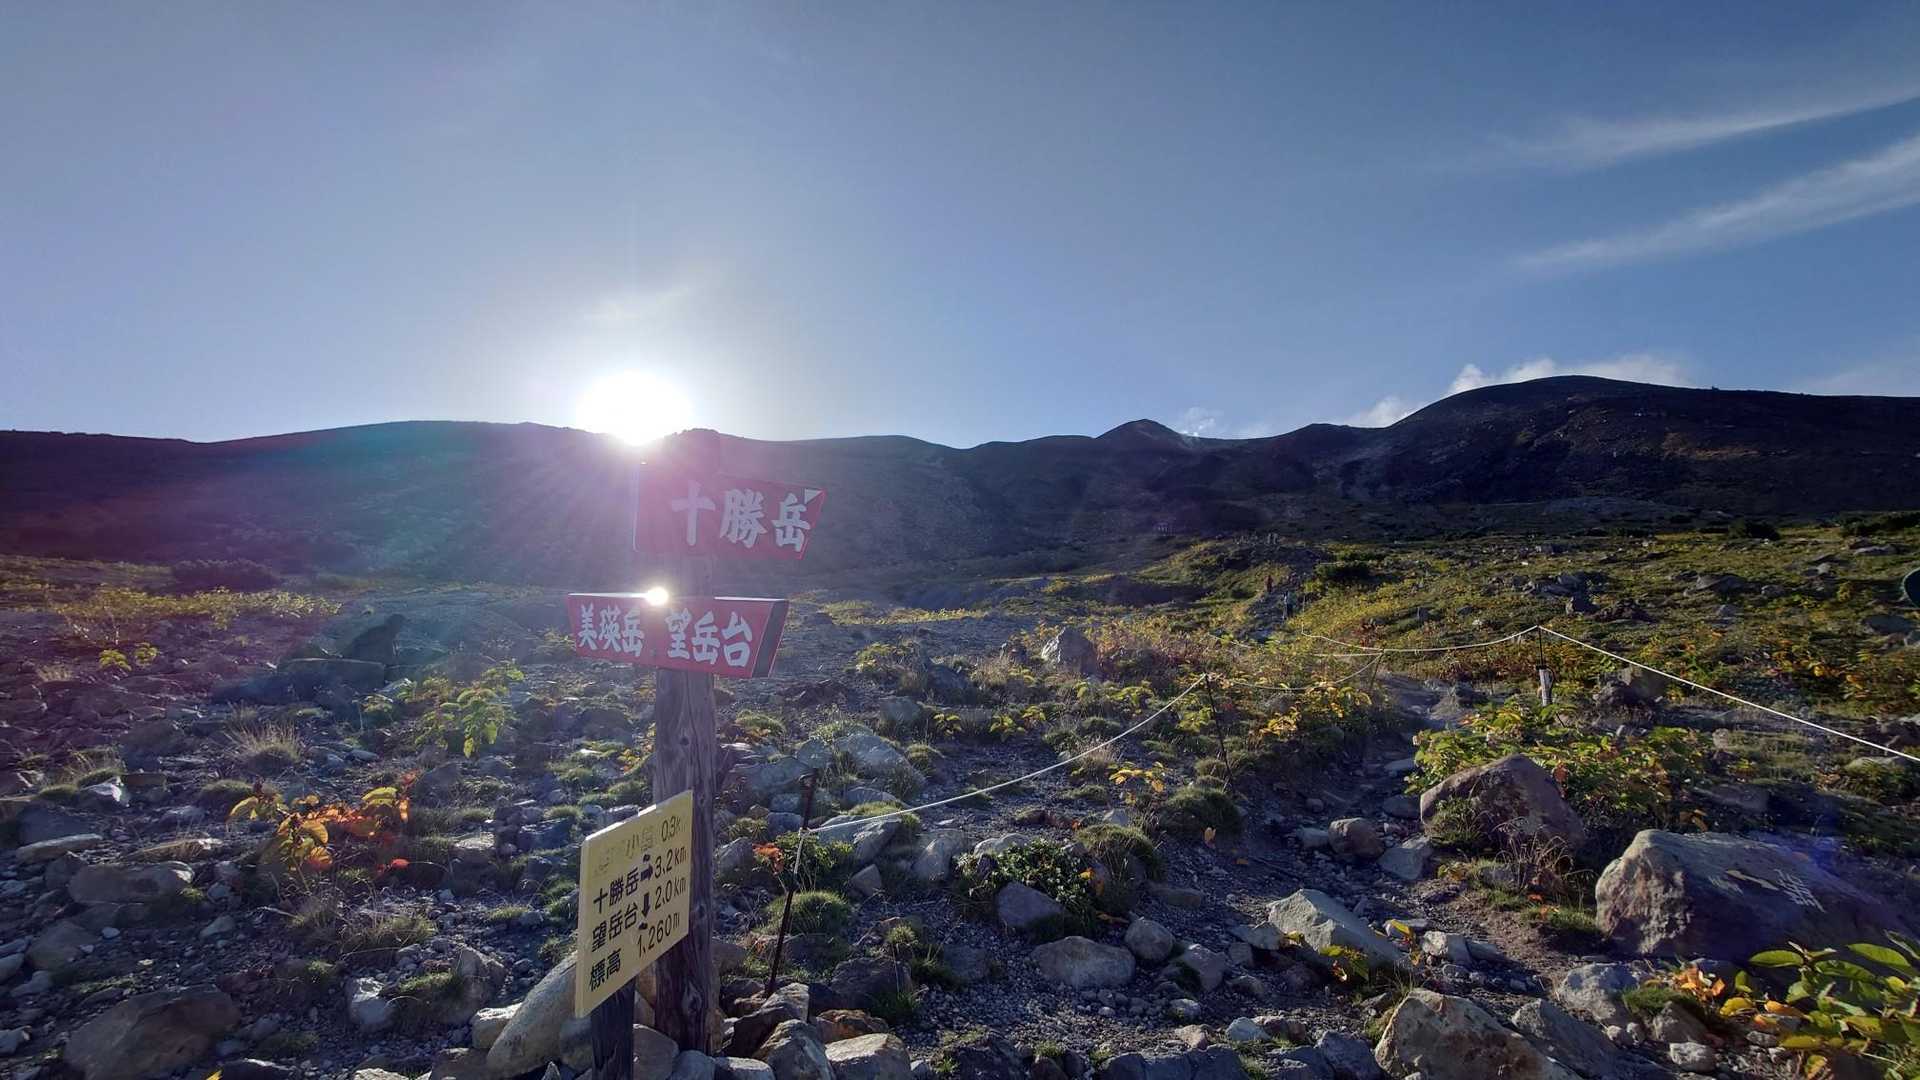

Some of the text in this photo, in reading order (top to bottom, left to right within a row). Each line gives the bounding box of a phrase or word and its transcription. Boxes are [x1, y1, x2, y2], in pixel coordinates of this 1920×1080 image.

[671, 480, 811, 552] 十勝岳
[577, 602, 645, 657] 美瑛岳
[664, 607, 753, 667] 望岳台
[593, 866, 639, 914] 十勝岳
[592, 902, 639, 954] 望岳台
[588, 948, 622, 993] 標高
